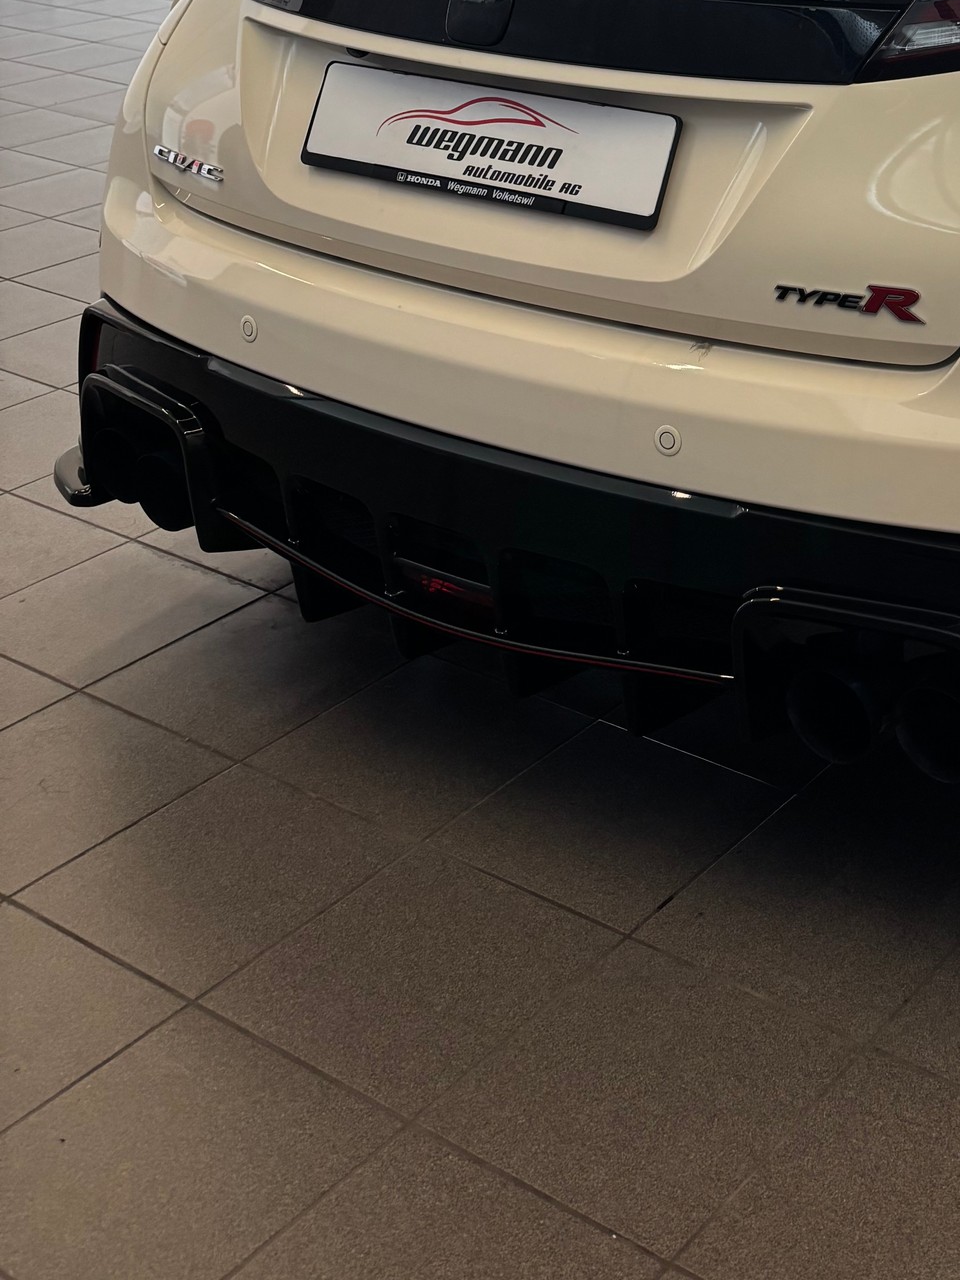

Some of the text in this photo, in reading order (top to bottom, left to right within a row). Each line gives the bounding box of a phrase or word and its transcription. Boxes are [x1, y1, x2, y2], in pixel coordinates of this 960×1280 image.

[153, 144, 224, 182] CIVIC
[406, 124, 563, 170] wegmann
[406, 174, 535, 206] HONDA Wegmann Volketswil
[559, 182, 582, 196] AG
